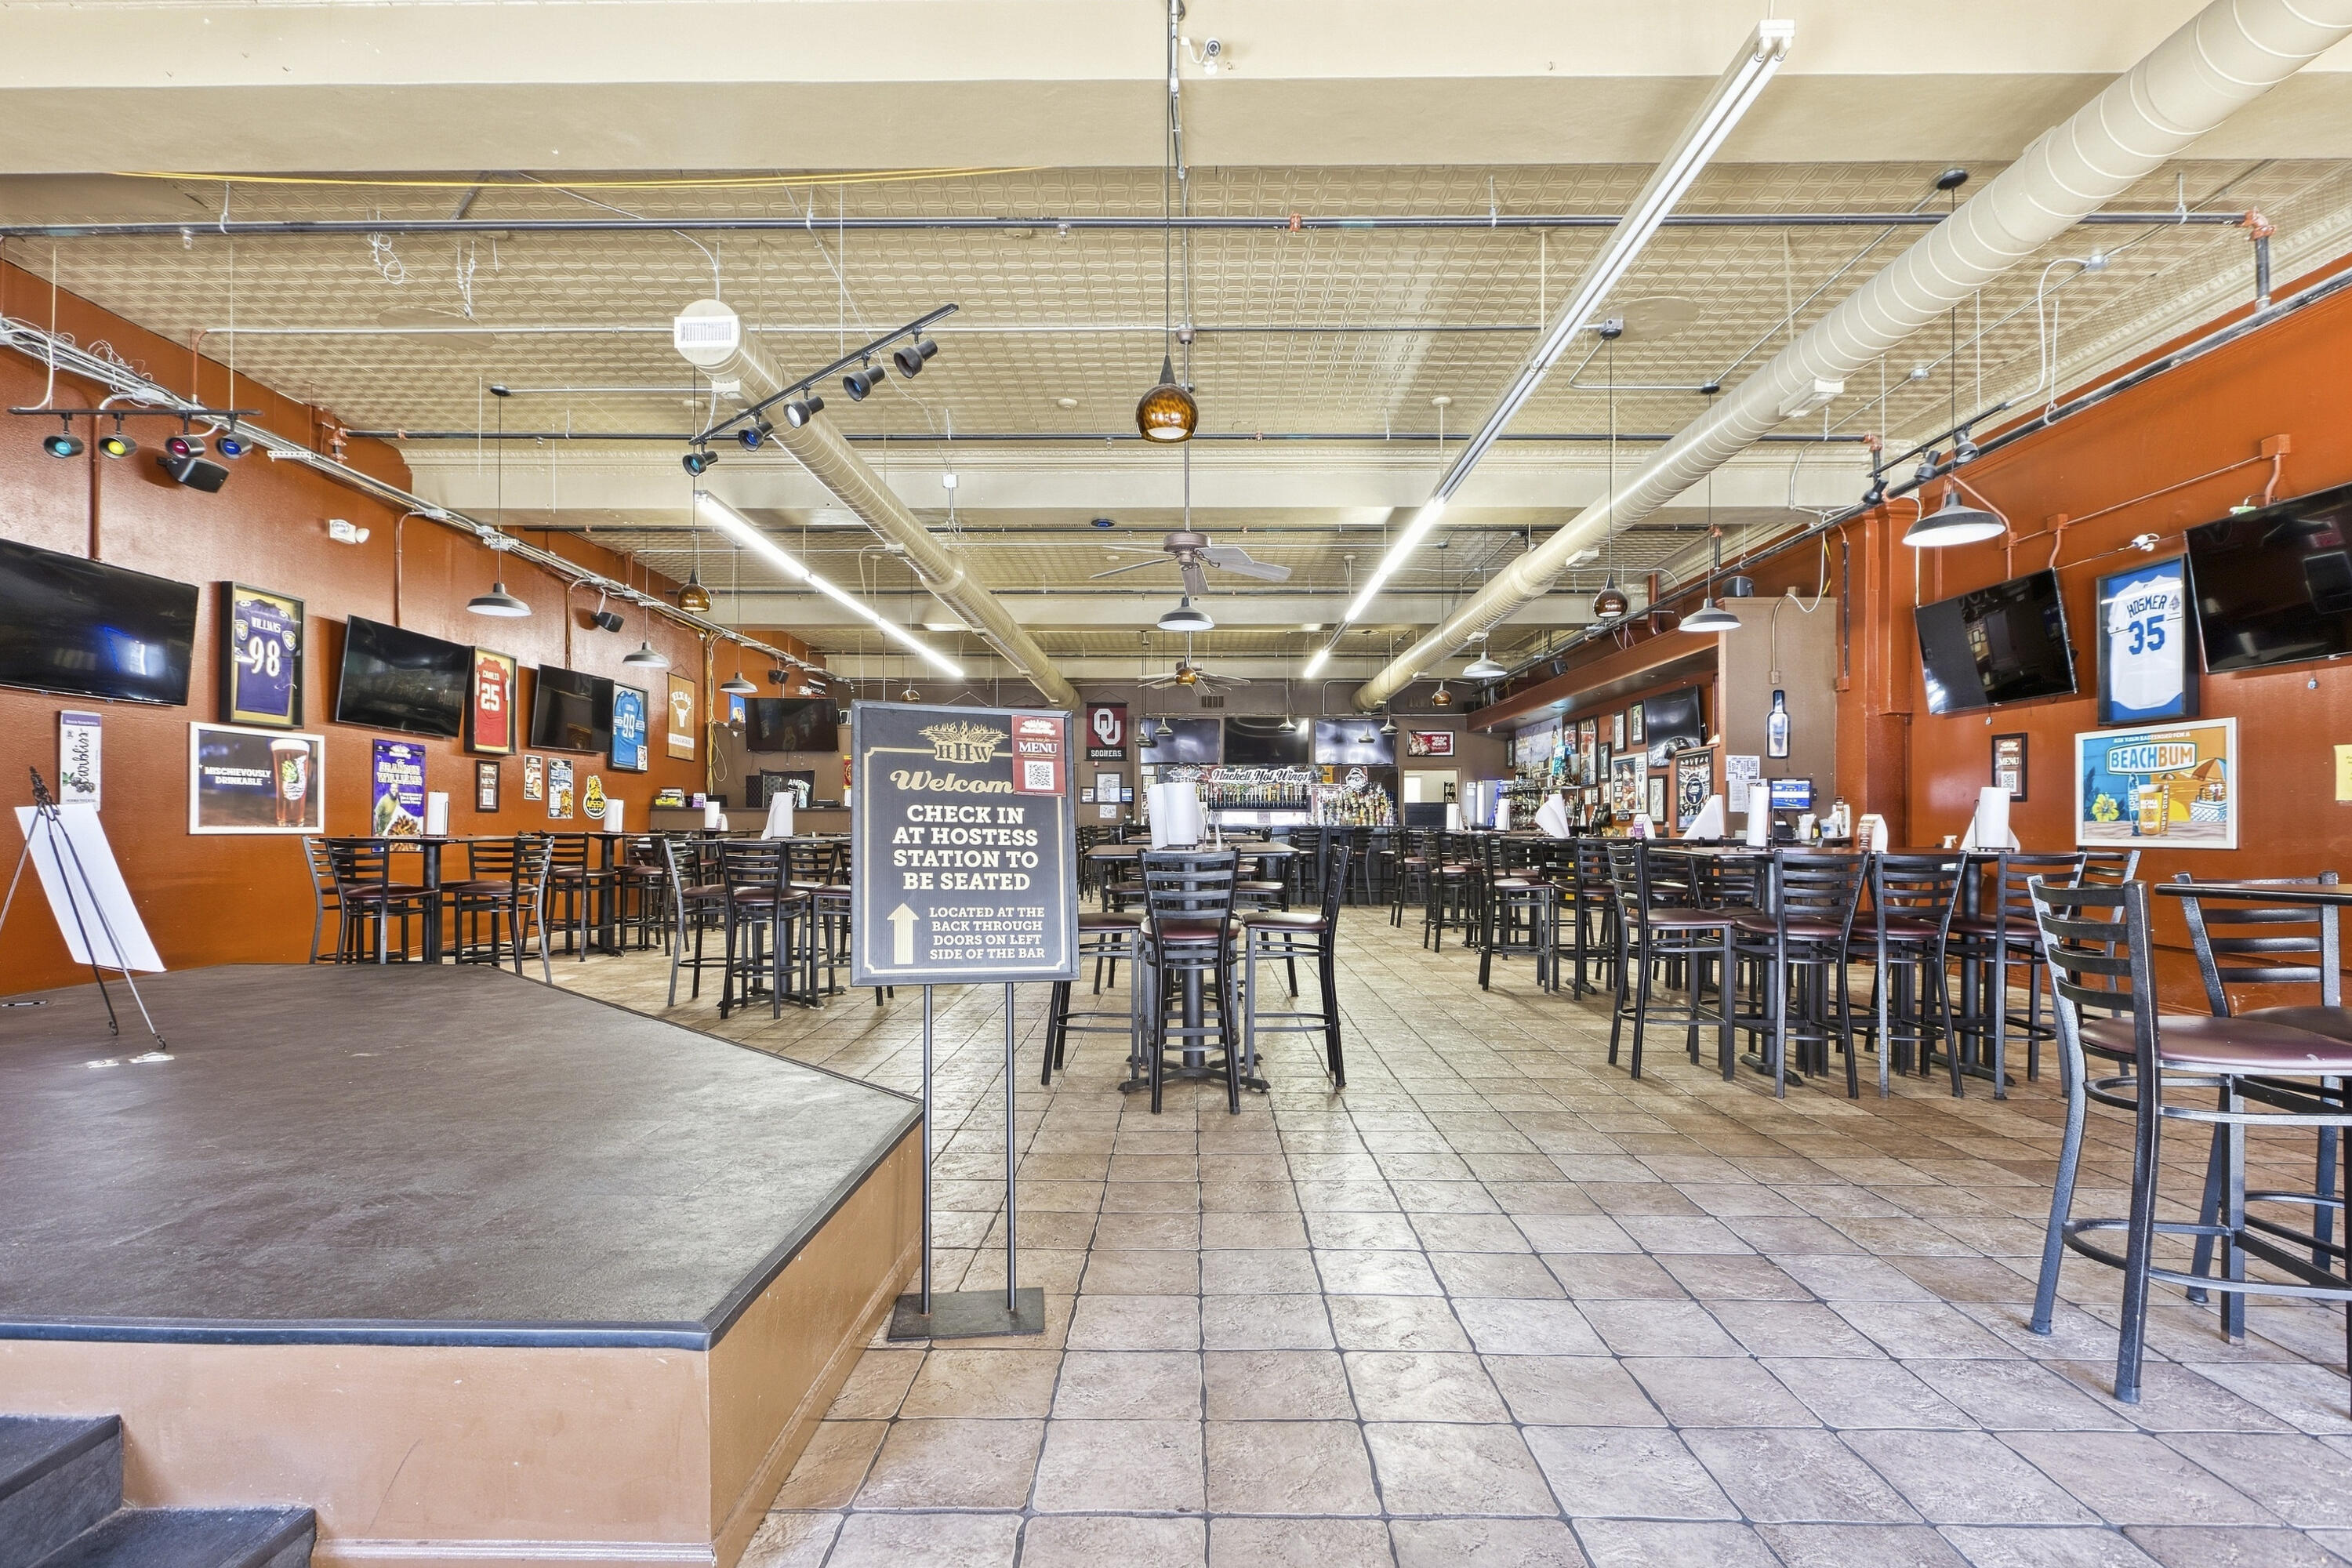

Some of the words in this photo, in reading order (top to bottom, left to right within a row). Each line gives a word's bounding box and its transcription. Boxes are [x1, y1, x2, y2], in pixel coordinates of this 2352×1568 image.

[2127, 595, 2167, 618] HOSMER
[2128, 615, 2165, 655] 35
[249, 637, 280, 677] 98
[481, 682, 500, 711] 25
[622, 713, 635, 739] 99
[1094, 708, 1121, 746] OU
[937, 742, 993, 761] HHW
[1018, 742, 1058, 753] MENU
[1999, 757, 2020, 765] MENU
[205, 767, 272, 779] MISCHIEVOUSLY
[215, 776, 263, 786] DRINKABLE
[890, 770, 1013, 793] Welcom
[1253, 769, 1274, 783] Hot
[1275, 768, 1310, 782] Wings
[907, 805, 991, 823] CHECK
[997, 807, 1025, 824] IN
[892, 826, 924, 844] AT
[931, 828, 1038, 847] HOSTESS
[893, 849, 1000, 868] STATION
[1006, 851, 1039, 869] TO
[903, 873, 934, 890] BE
[940, 873, 1030, 891] SEATED
[929, 907, 994, 918] LOCATED
[997, 907, 1014, 917] AT
[1017, 907, 1045, 917] THE
[931, 920, 970, 931] BACK
[973, 920, 1043, 931] THROUGH
[933, 935, 982, 946] DOORS
[985, 935, 1007, 945] ON
[1009, 934, 1042, 945] LEFT
[930, 949, 963, 960] SIDE
[965, 949, 985, 959] OF
[986, 948, 1015, 959] THE
[1018, 948, 1045, 958] BAR
